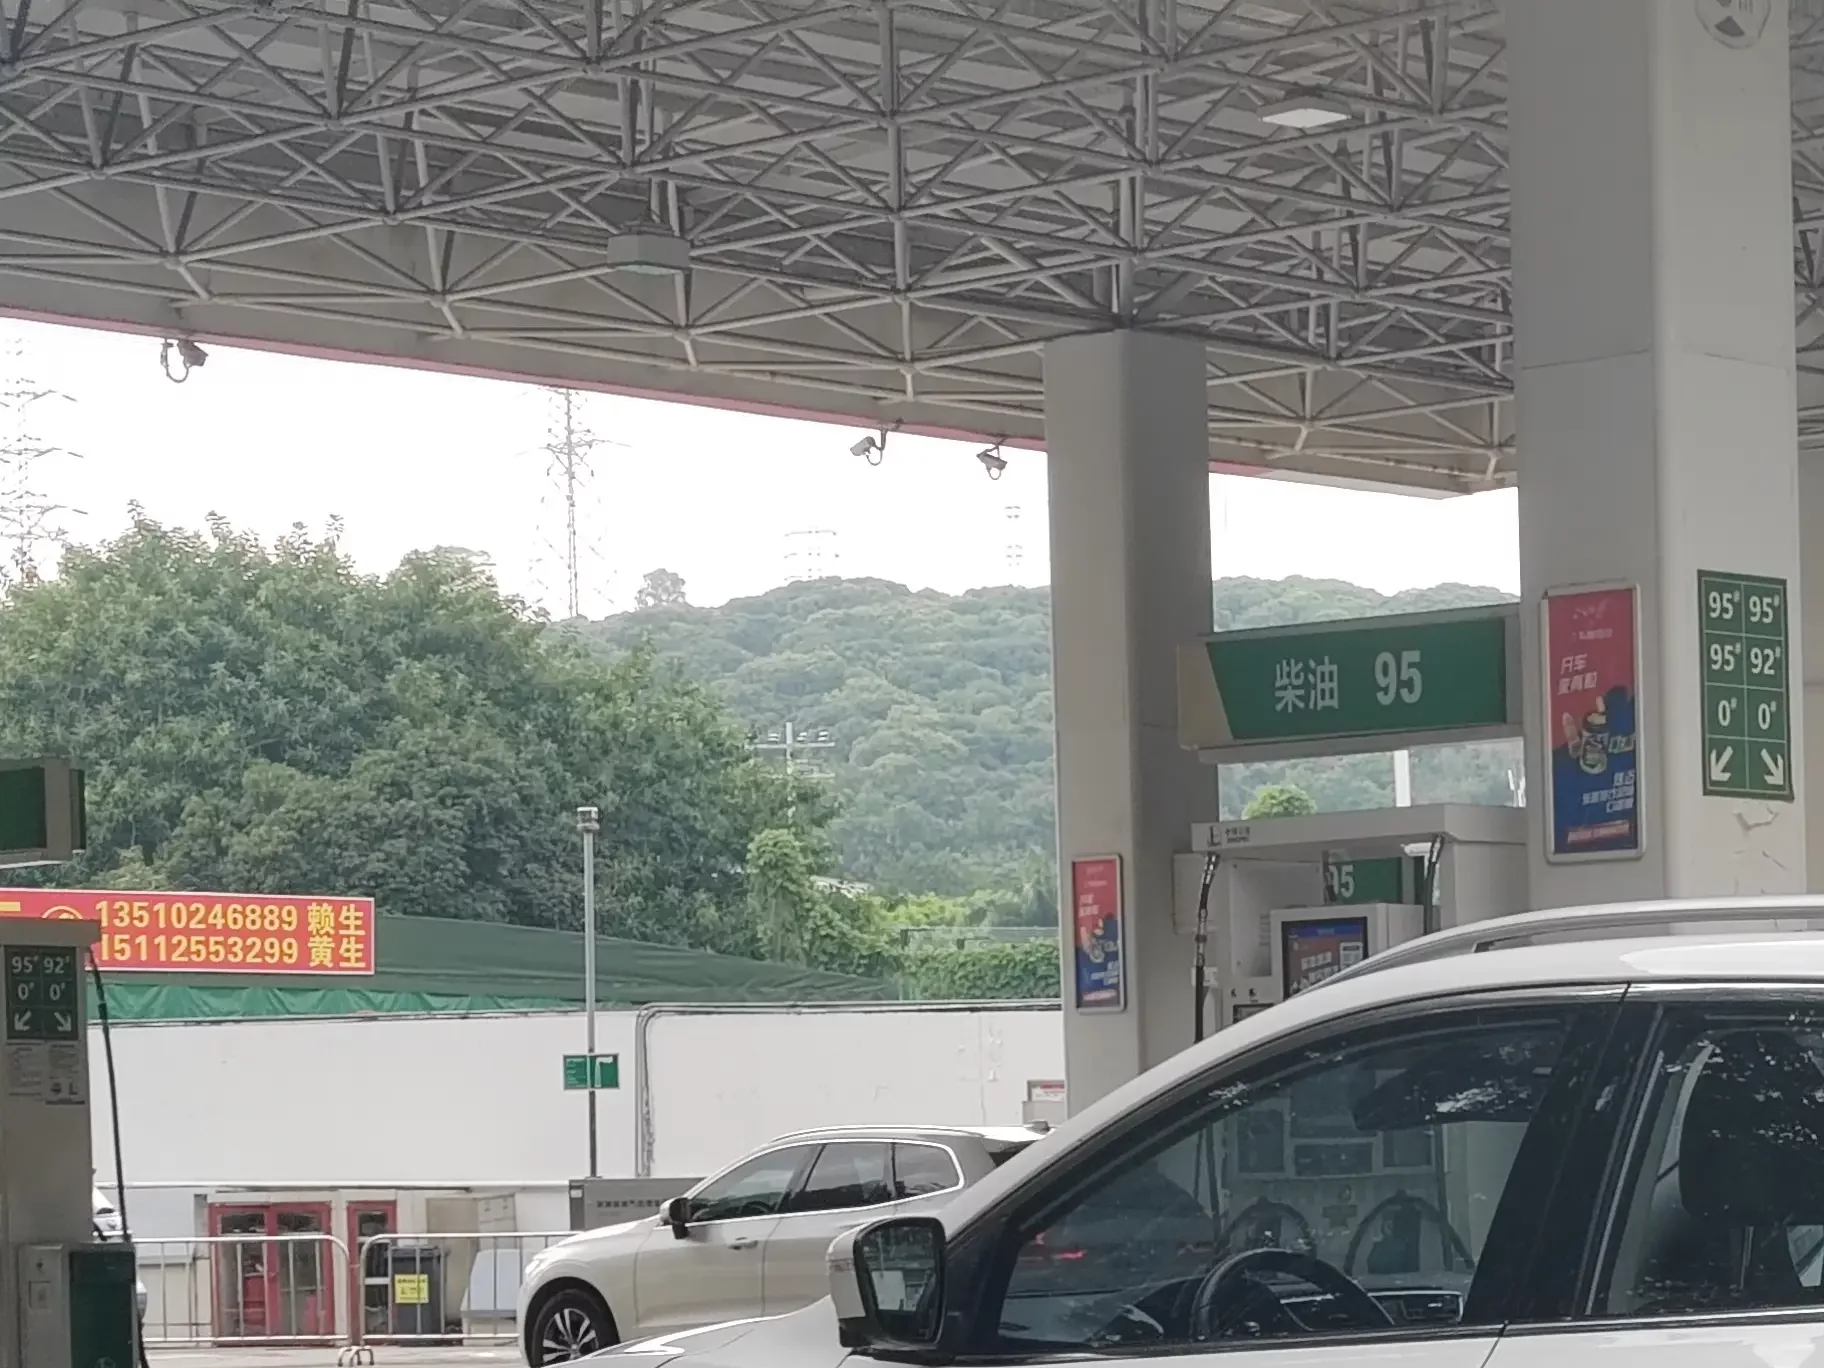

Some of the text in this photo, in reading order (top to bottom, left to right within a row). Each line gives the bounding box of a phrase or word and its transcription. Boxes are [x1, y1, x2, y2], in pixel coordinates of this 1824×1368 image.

[1275, 650, 1422, 713] 柴油 95
[95, 900, 366, 935] 13510246889 赖生
[101, 932, 366, 968] 15112553299 黄生
